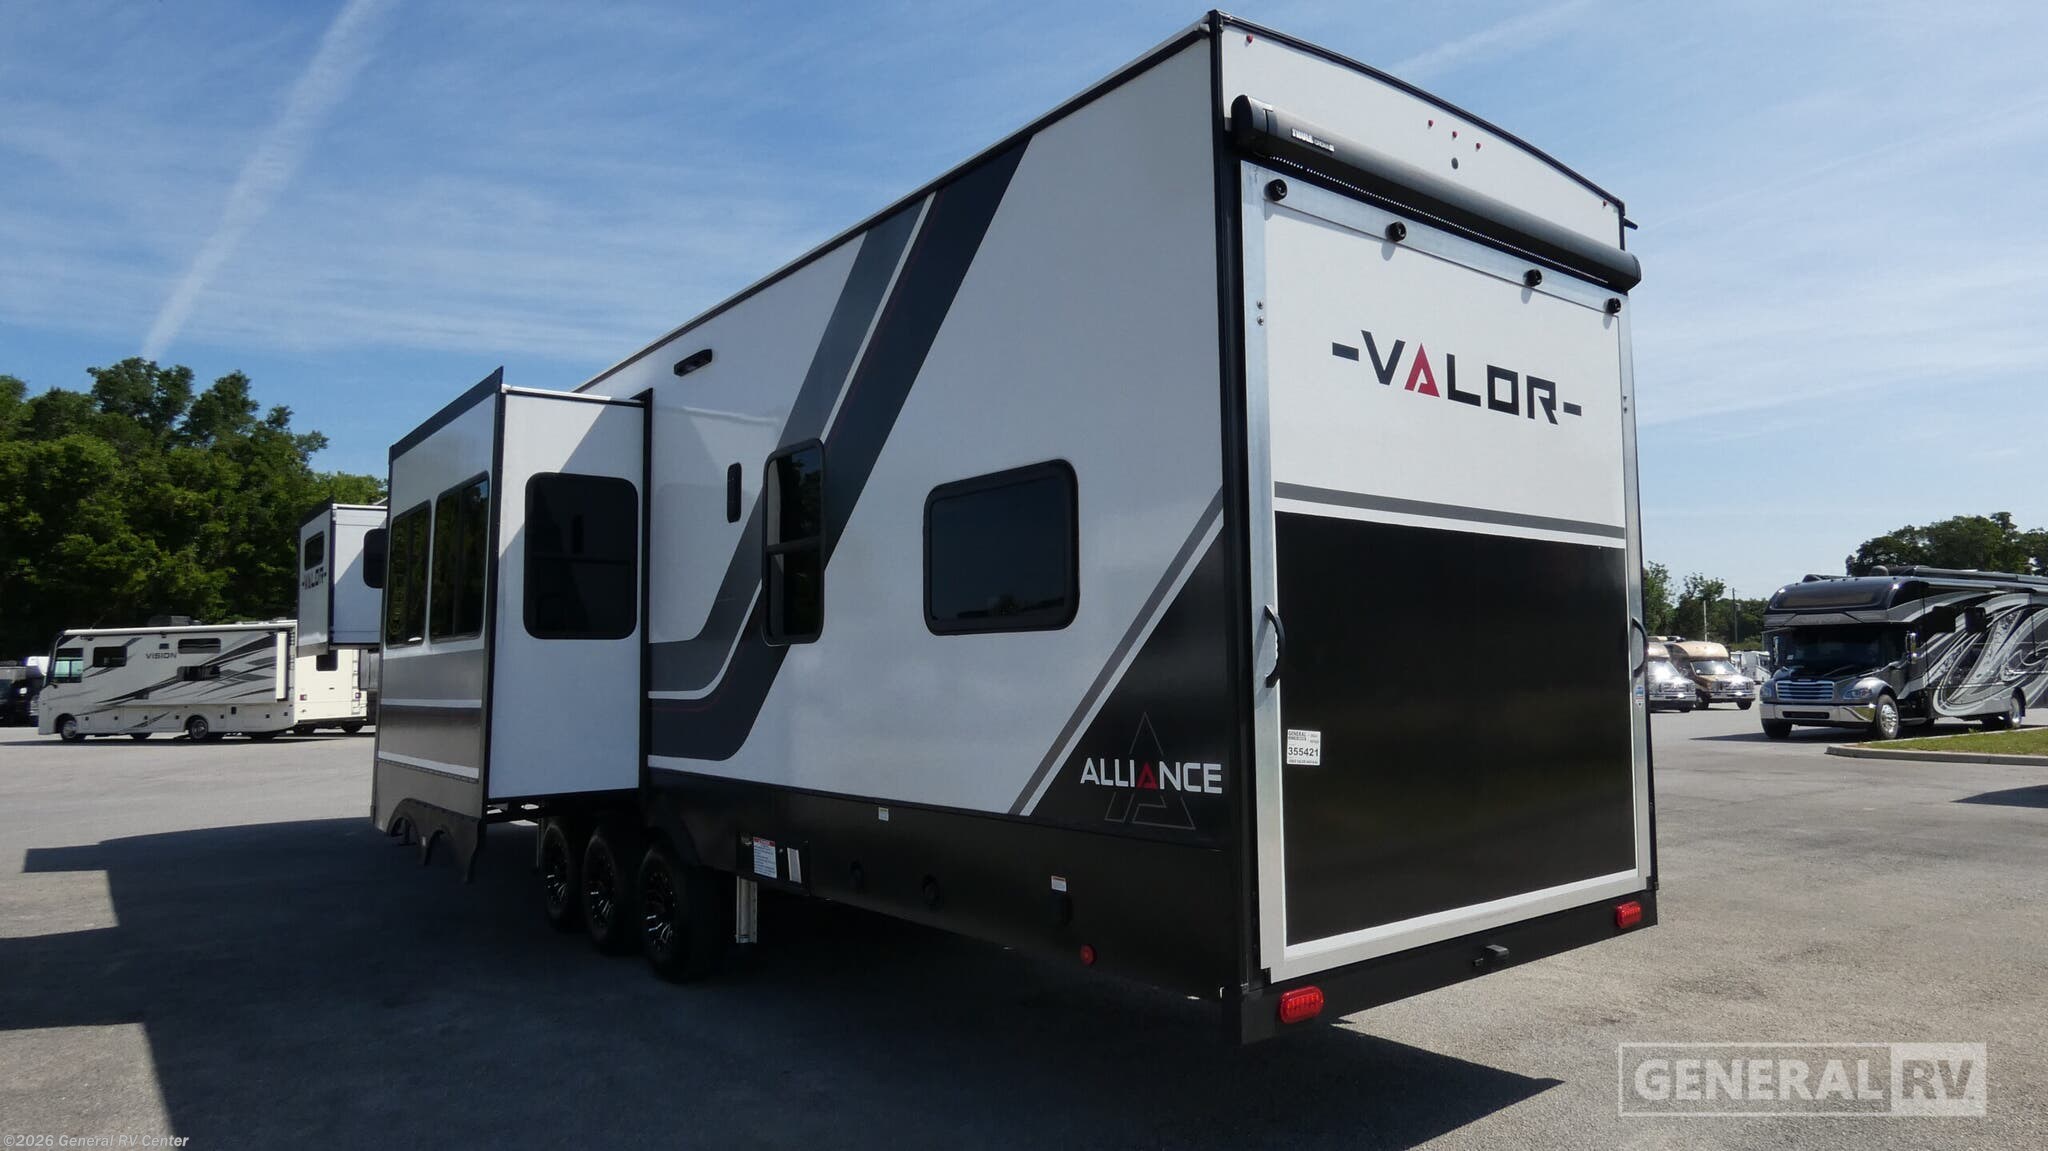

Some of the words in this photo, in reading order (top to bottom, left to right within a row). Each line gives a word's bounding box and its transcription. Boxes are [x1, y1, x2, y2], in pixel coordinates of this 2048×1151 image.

[145, 652, 177, 660] VISION
[1288, 747, 1319, 757] 355421
[1080, 757, 1223, 794] ALLIANCE
